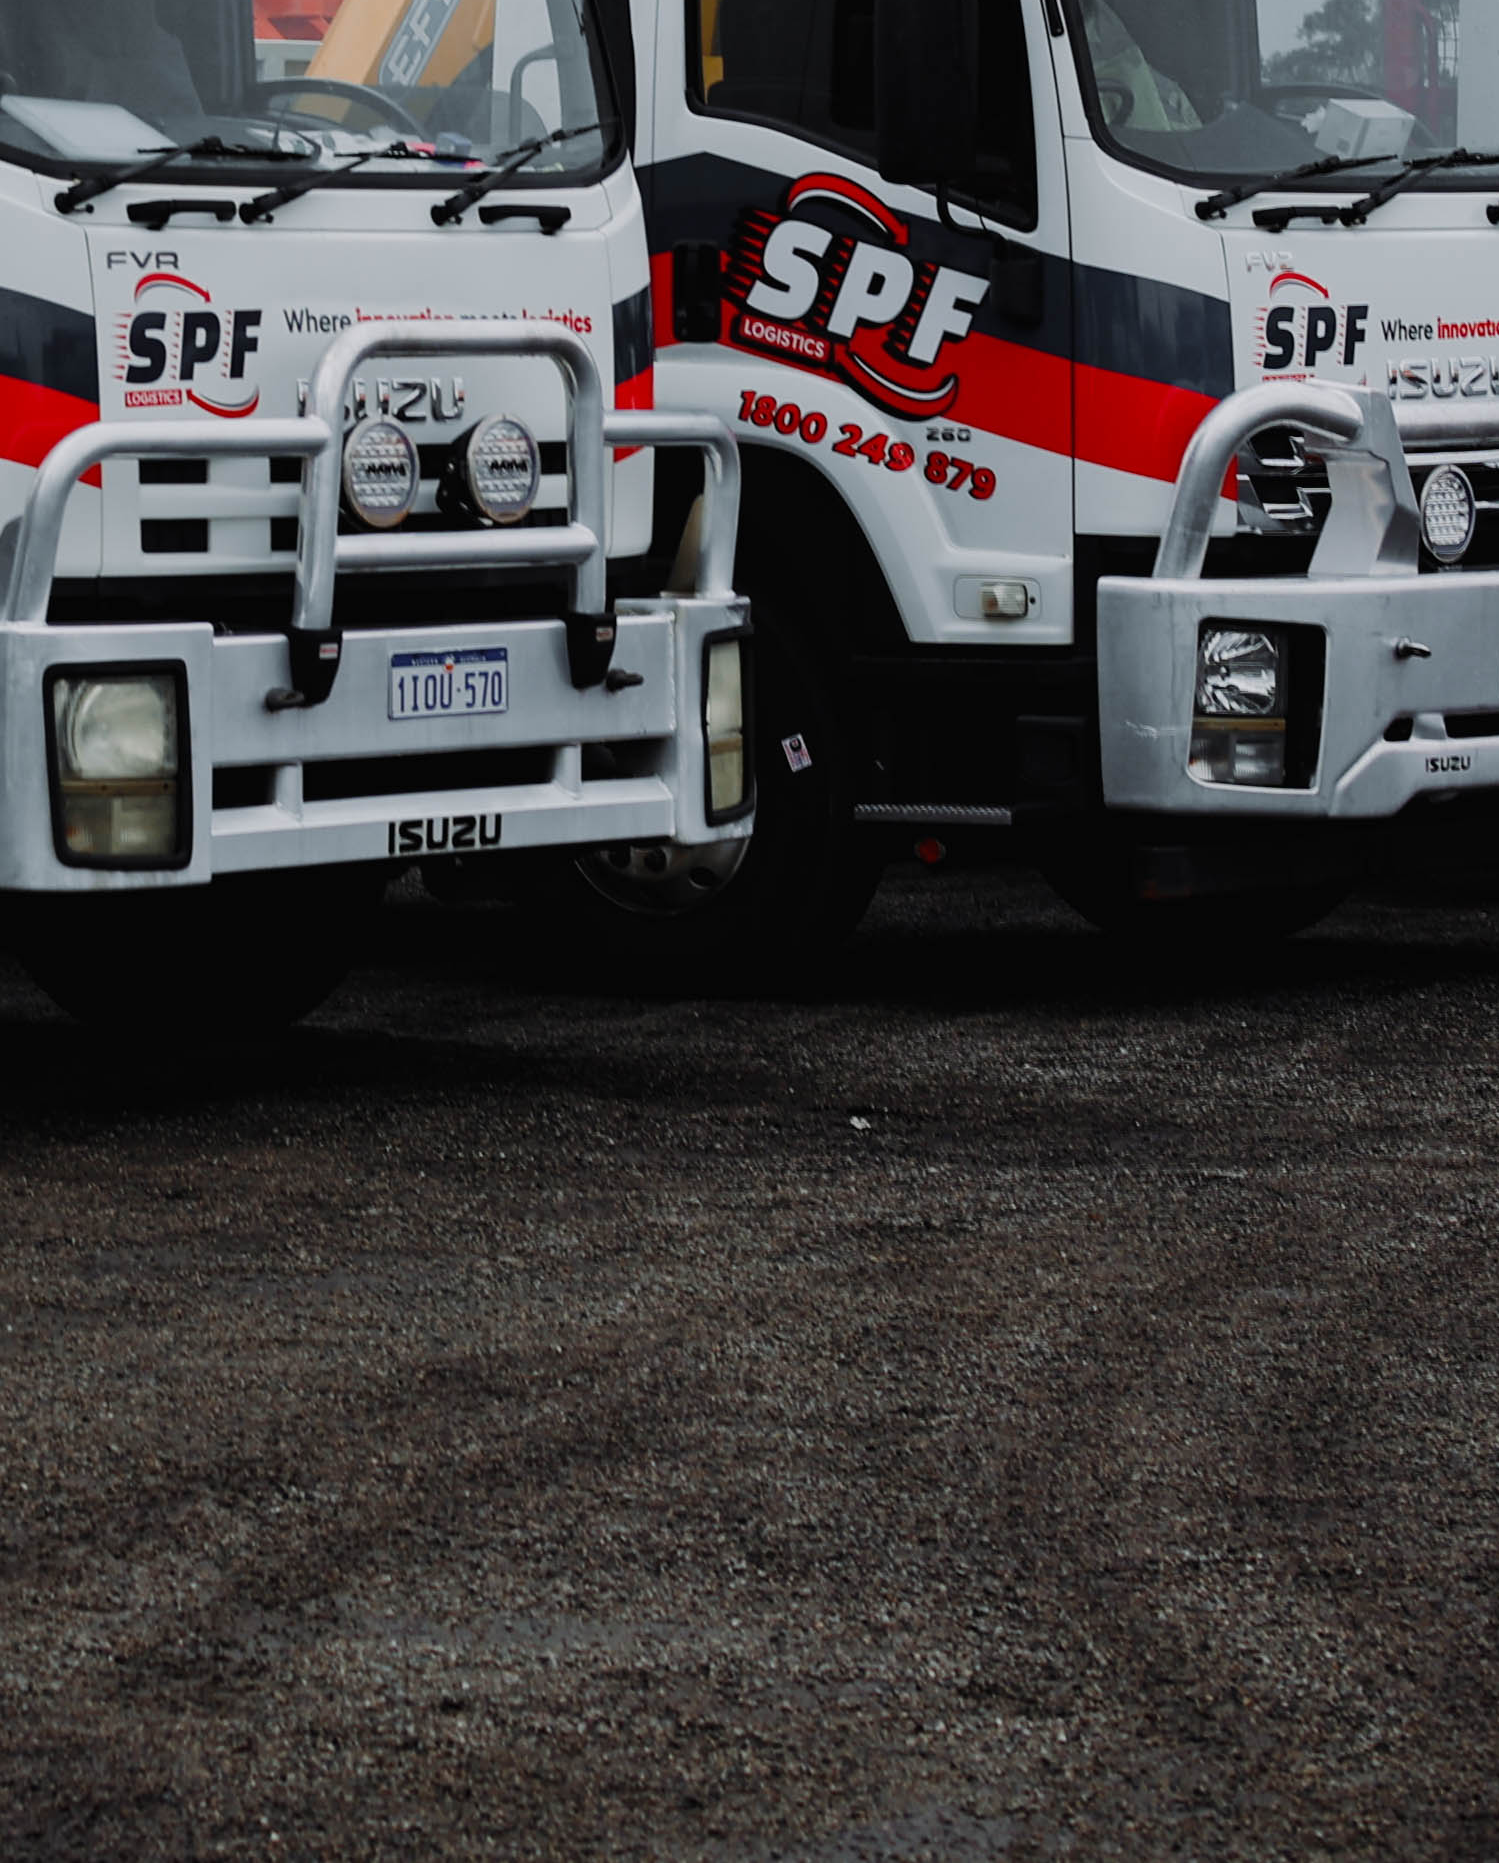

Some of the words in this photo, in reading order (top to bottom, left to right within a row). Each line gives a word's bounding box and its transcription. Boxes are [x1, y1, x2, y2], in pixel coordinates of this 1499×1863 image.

[106, 251, 179, 270] FVR
[746, 217, 991, 366] SPF
[284, 308, 351, 333] Where
[743, 318, 826, 360] LOGISTICS
[1263, 304, 1369, 370] SPF
[1380, 318, 1433, 342] Where
[125, 309, 262, 384] SPF
[126, 390, 181, 406] LOGISTICS
[296, 377, 466, 422] IUZU
[739, 390, 828, 444] 1800
[833, 423, 915, 472] 249
[923, 451, 997, 501] 879
[1425, 755, 1471, 773] ISUZU
[388, 812, 502, 856] ISUZU
